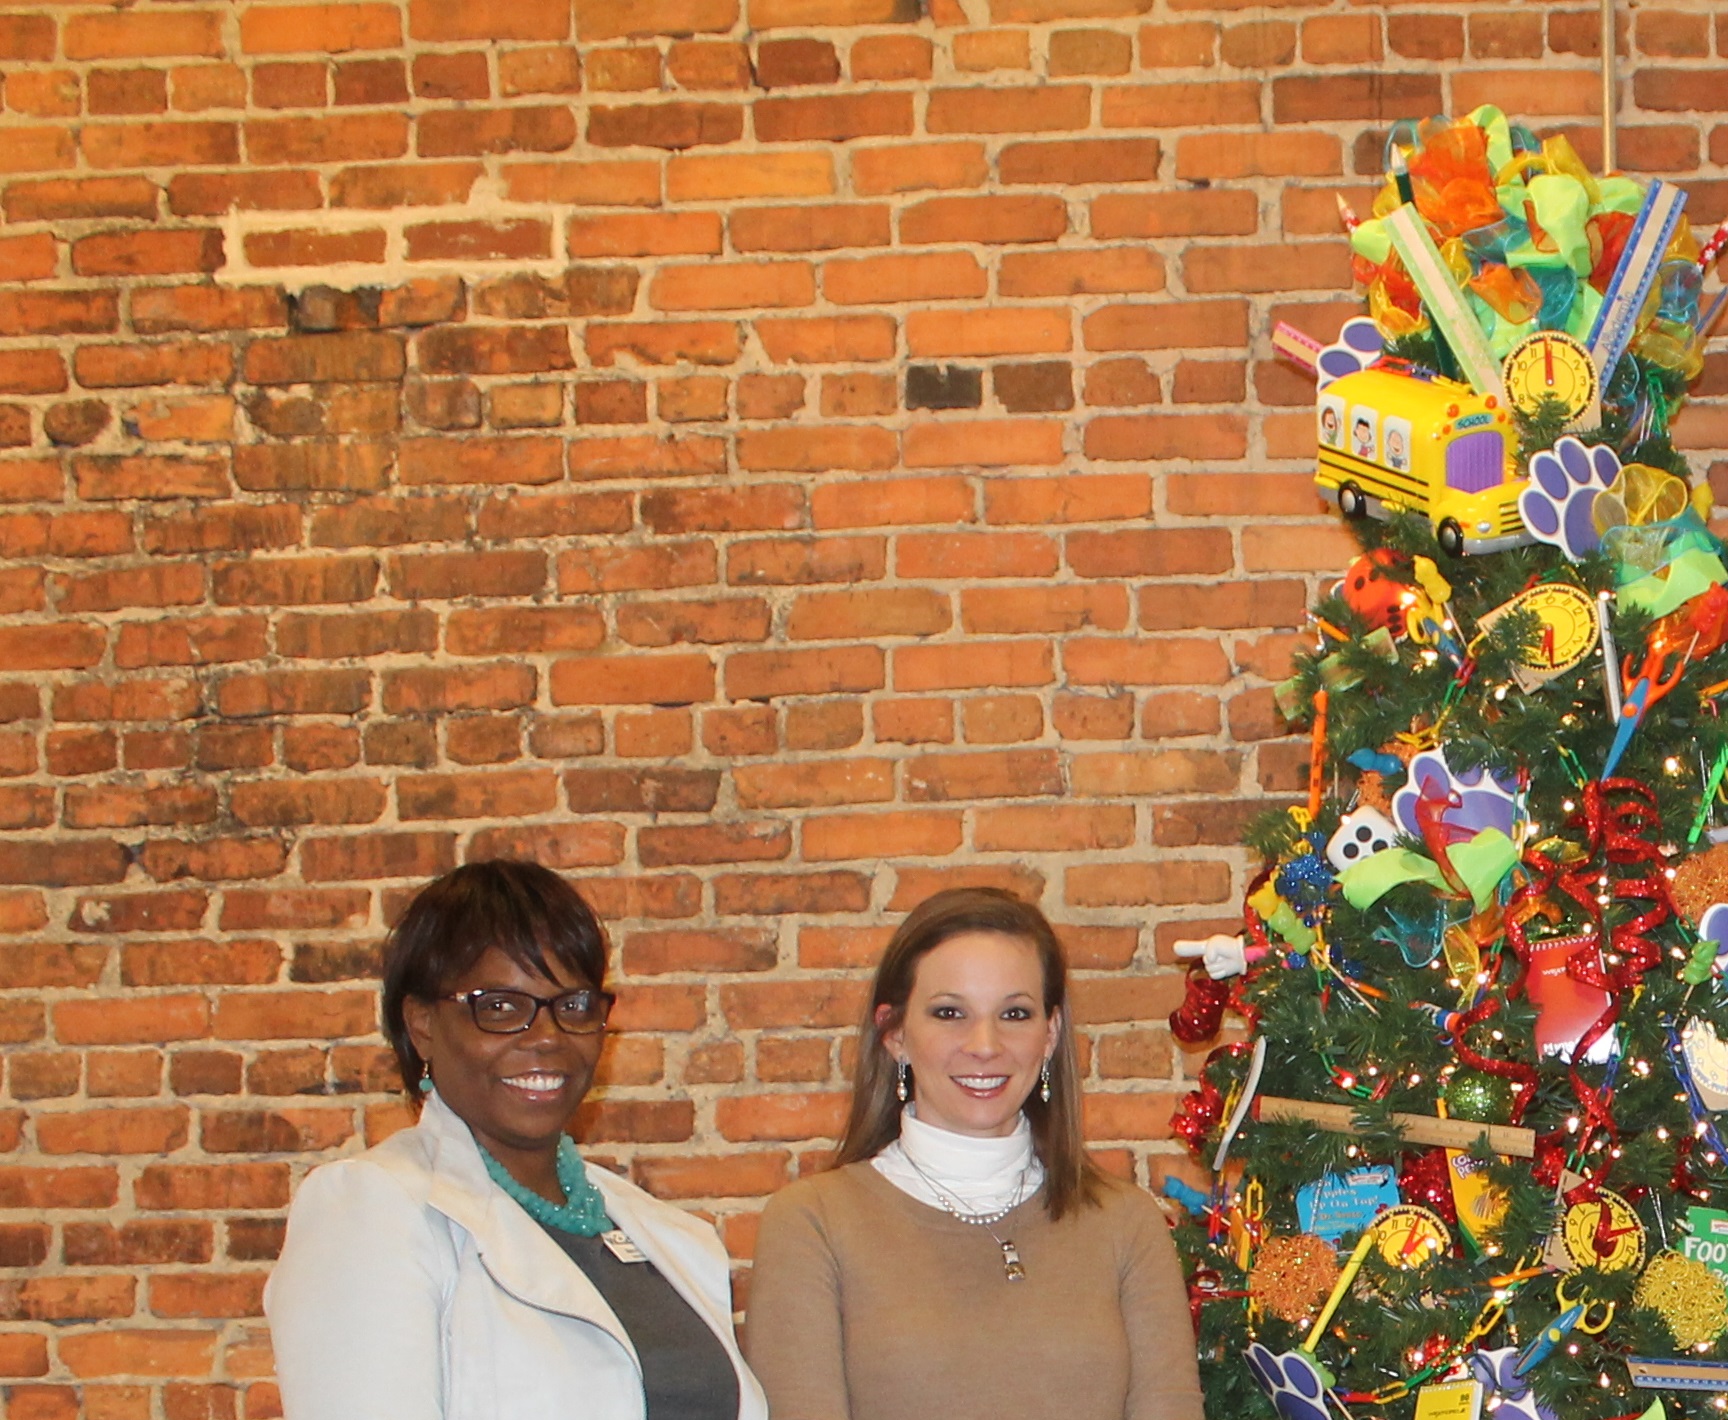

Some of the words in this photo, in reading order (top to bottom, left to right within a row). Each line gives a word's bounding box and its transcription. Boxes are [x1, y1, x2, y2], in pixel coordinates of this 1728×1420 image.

[1517, 360, 1528, 372] 10
[1572, 359, 1581, 371] 2
[1512, 376, 1520, 388] 9
[1579, 376, 1587, 387] 3
[1456, 414, 1491, 430] SCHOOL
[1391, 1219, 1399, 1230] 11
[1405, 1217, 1415, 1229] 12
